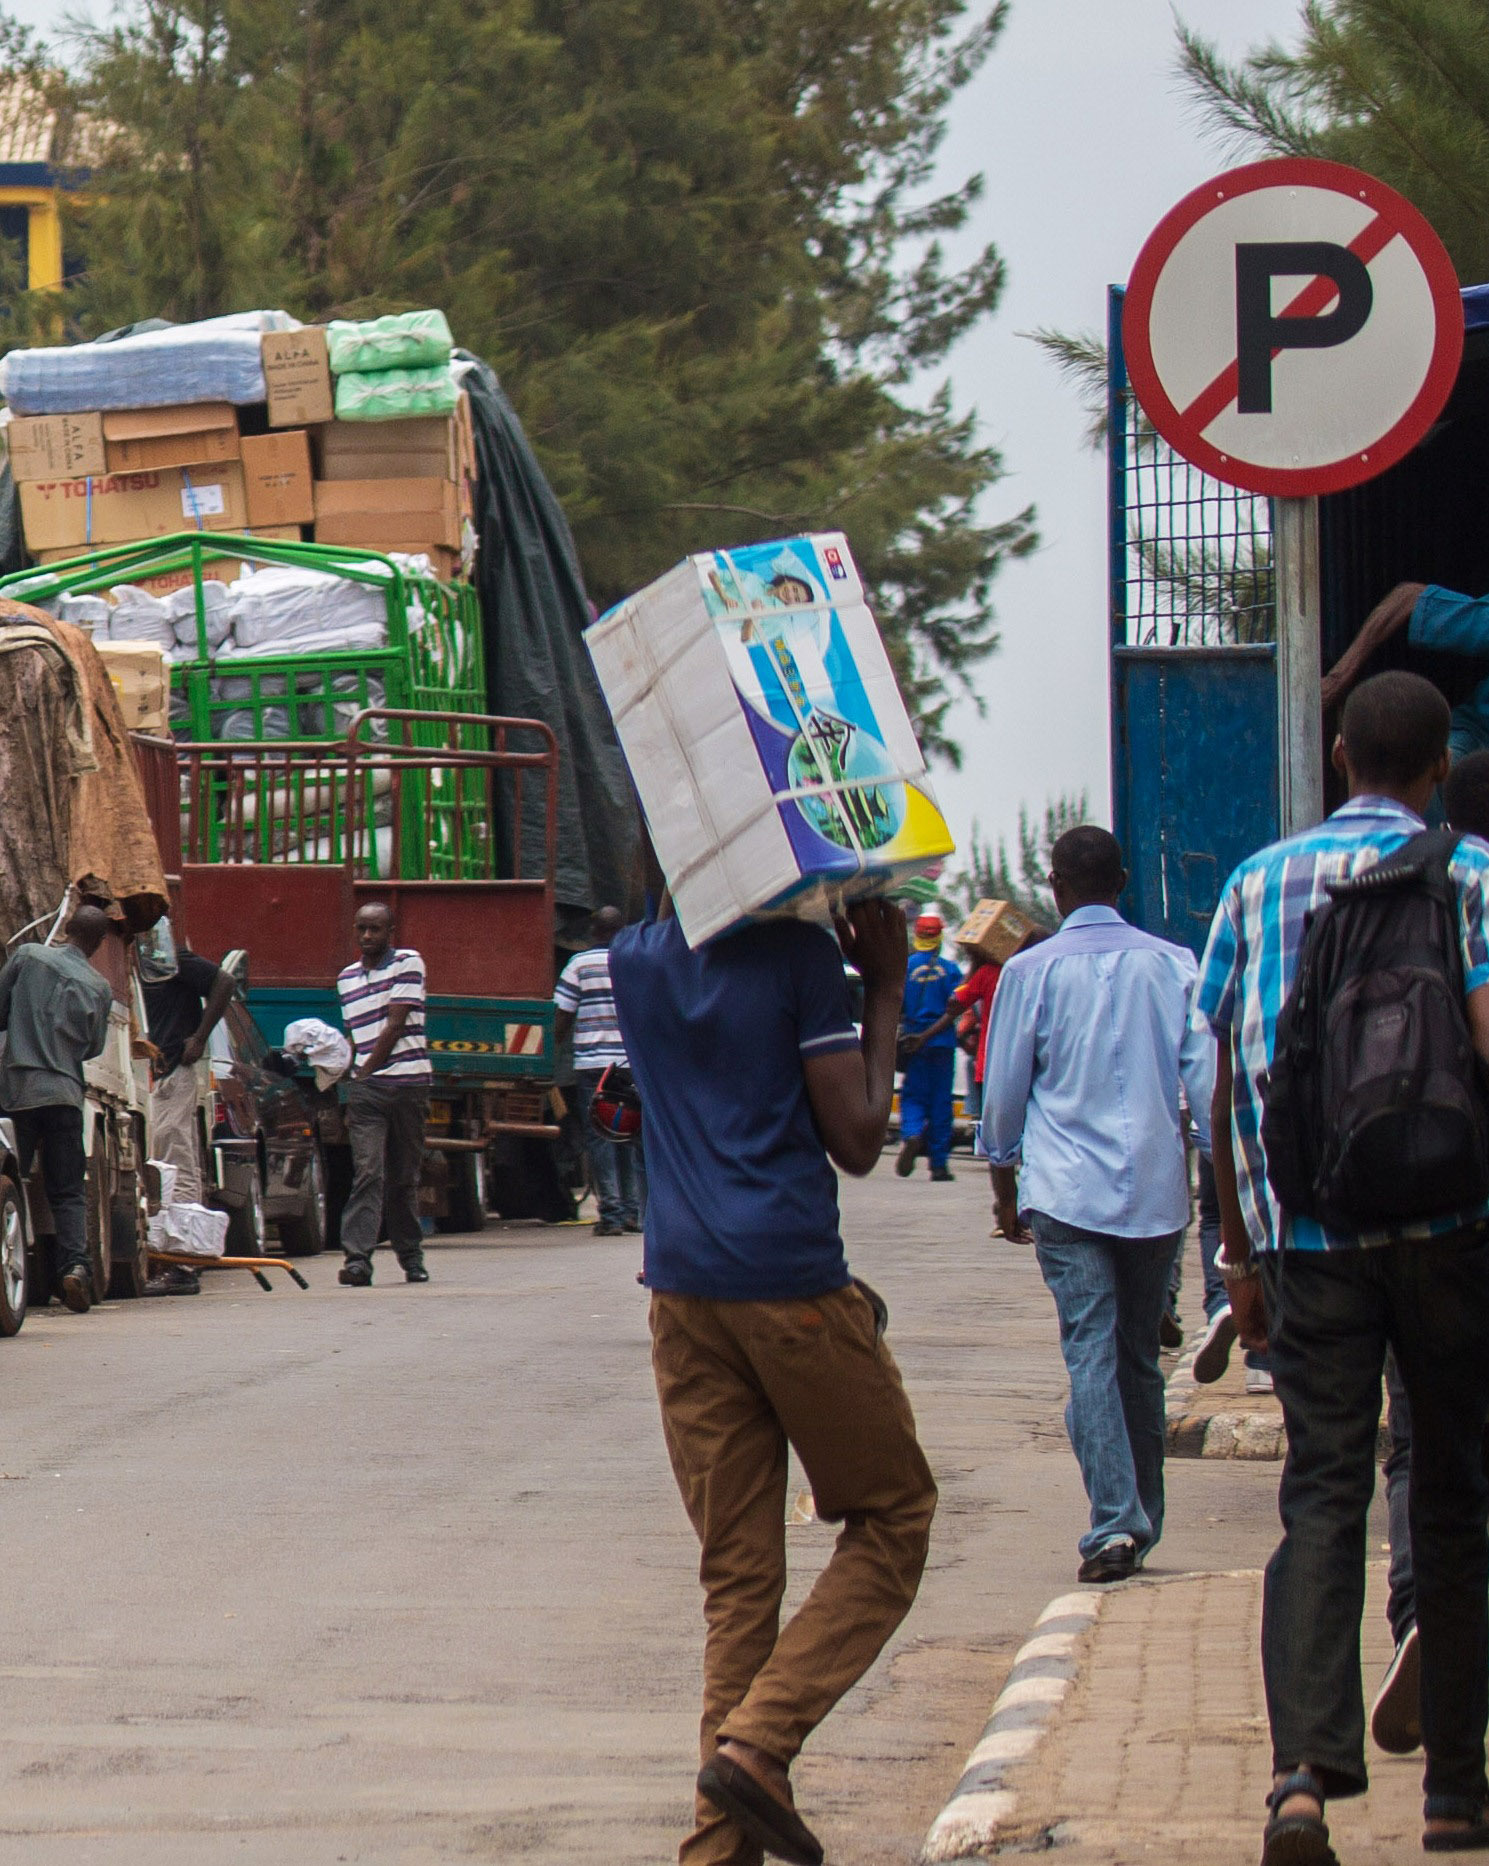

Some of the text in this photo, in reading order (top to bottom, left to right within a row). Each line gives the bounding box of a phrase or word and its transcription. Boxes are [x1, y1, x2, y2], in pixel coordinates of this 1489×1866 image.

[1235, 241, 1373, 414] P
[275, 348, 309, 360] ALFA
[72, 426, 83, 460] ALFA
[61, 472, 161, 499] TOHATSU
